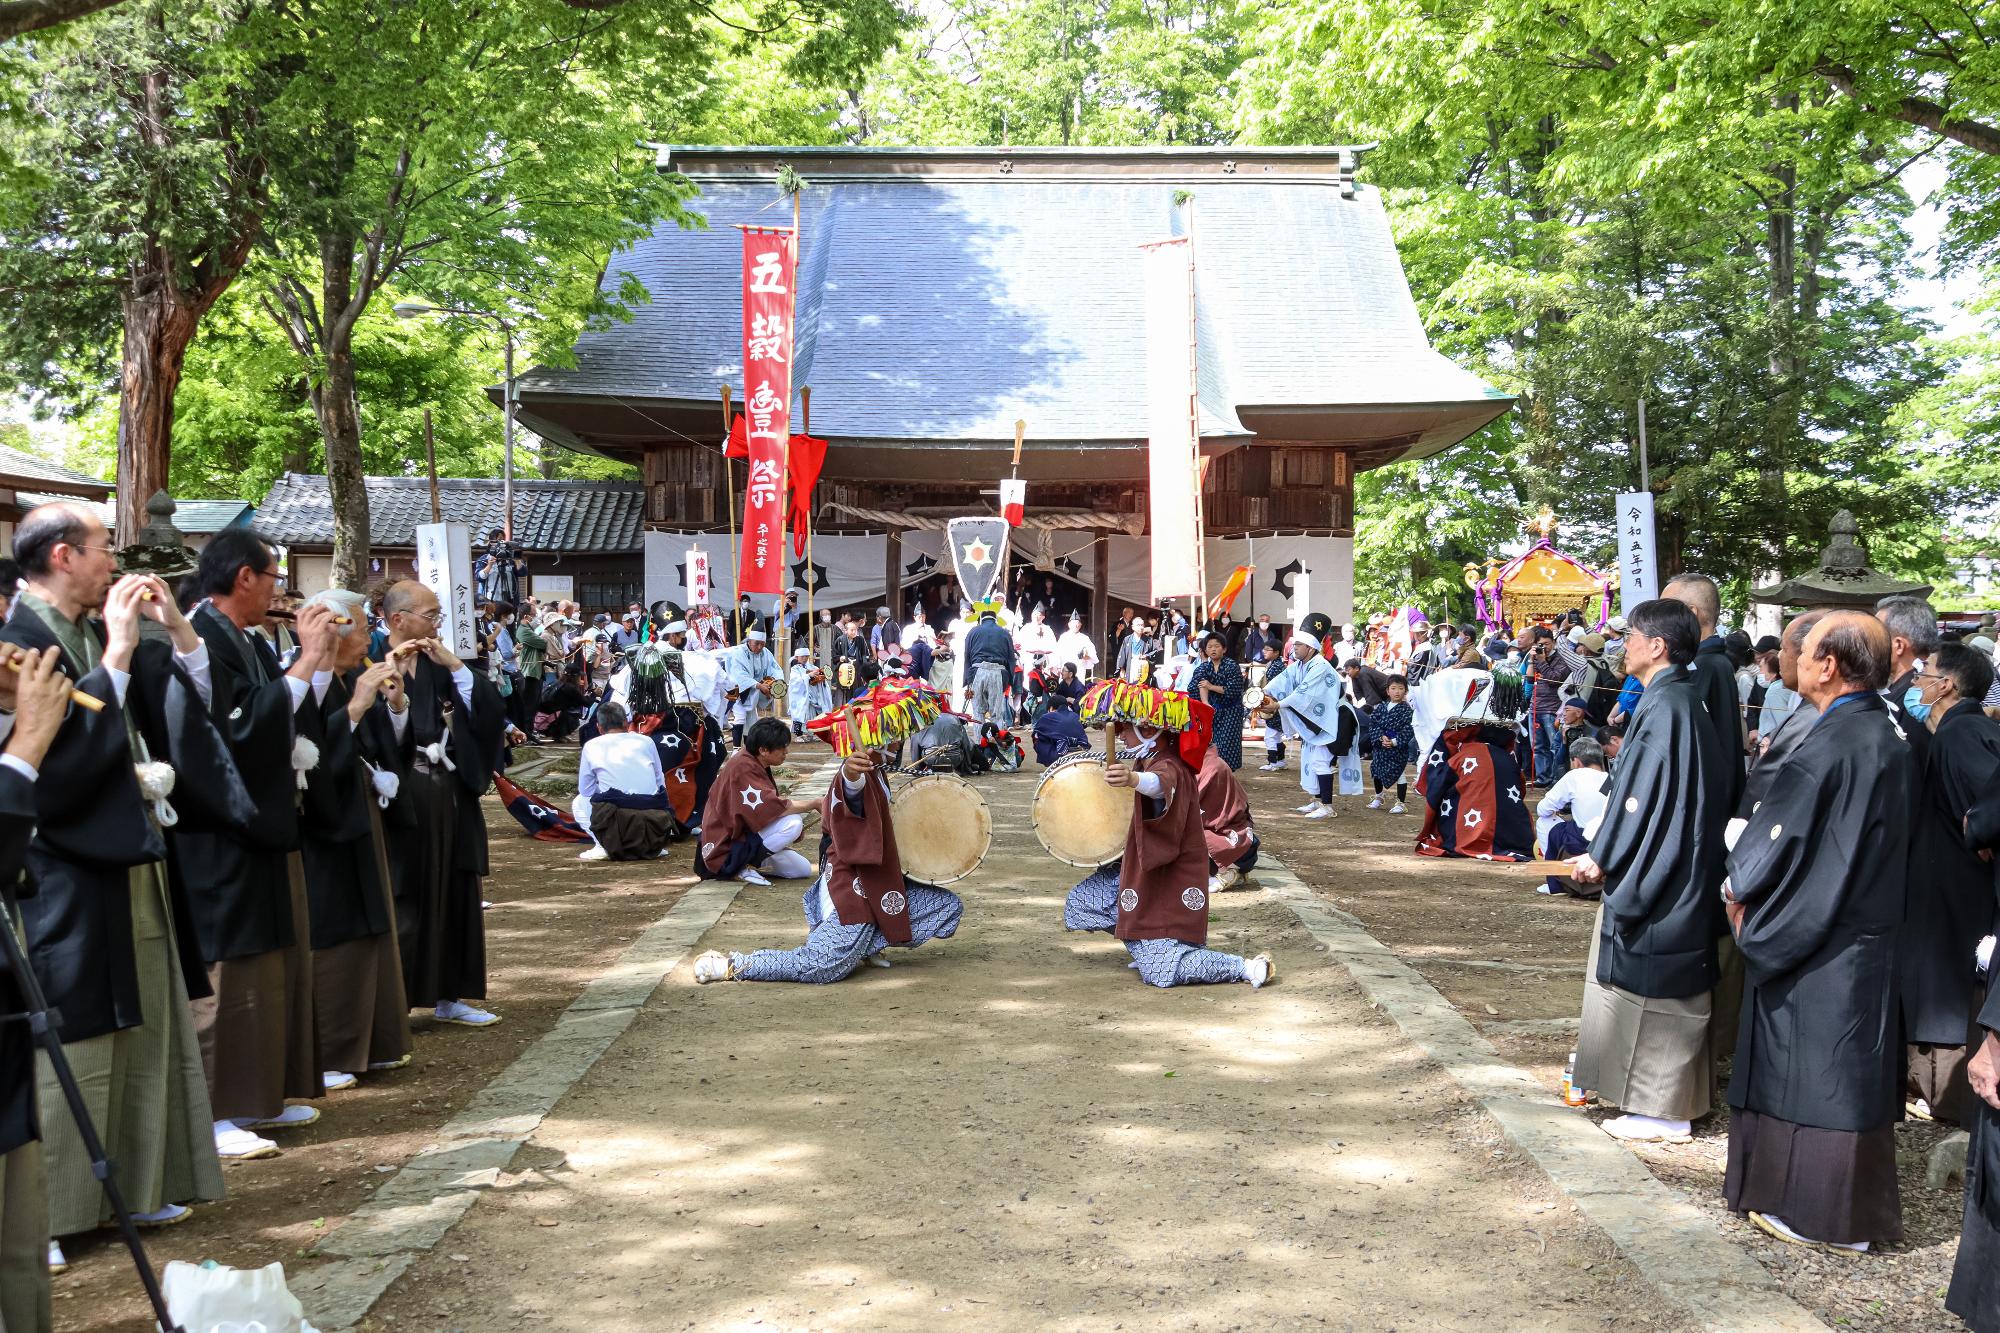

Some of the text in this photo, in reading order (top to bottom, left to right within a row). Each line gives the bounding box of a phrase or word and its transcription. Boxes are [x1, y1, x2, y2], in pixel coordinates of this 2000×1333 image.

[1627, 506, 1643, 588] 令和五年四月
